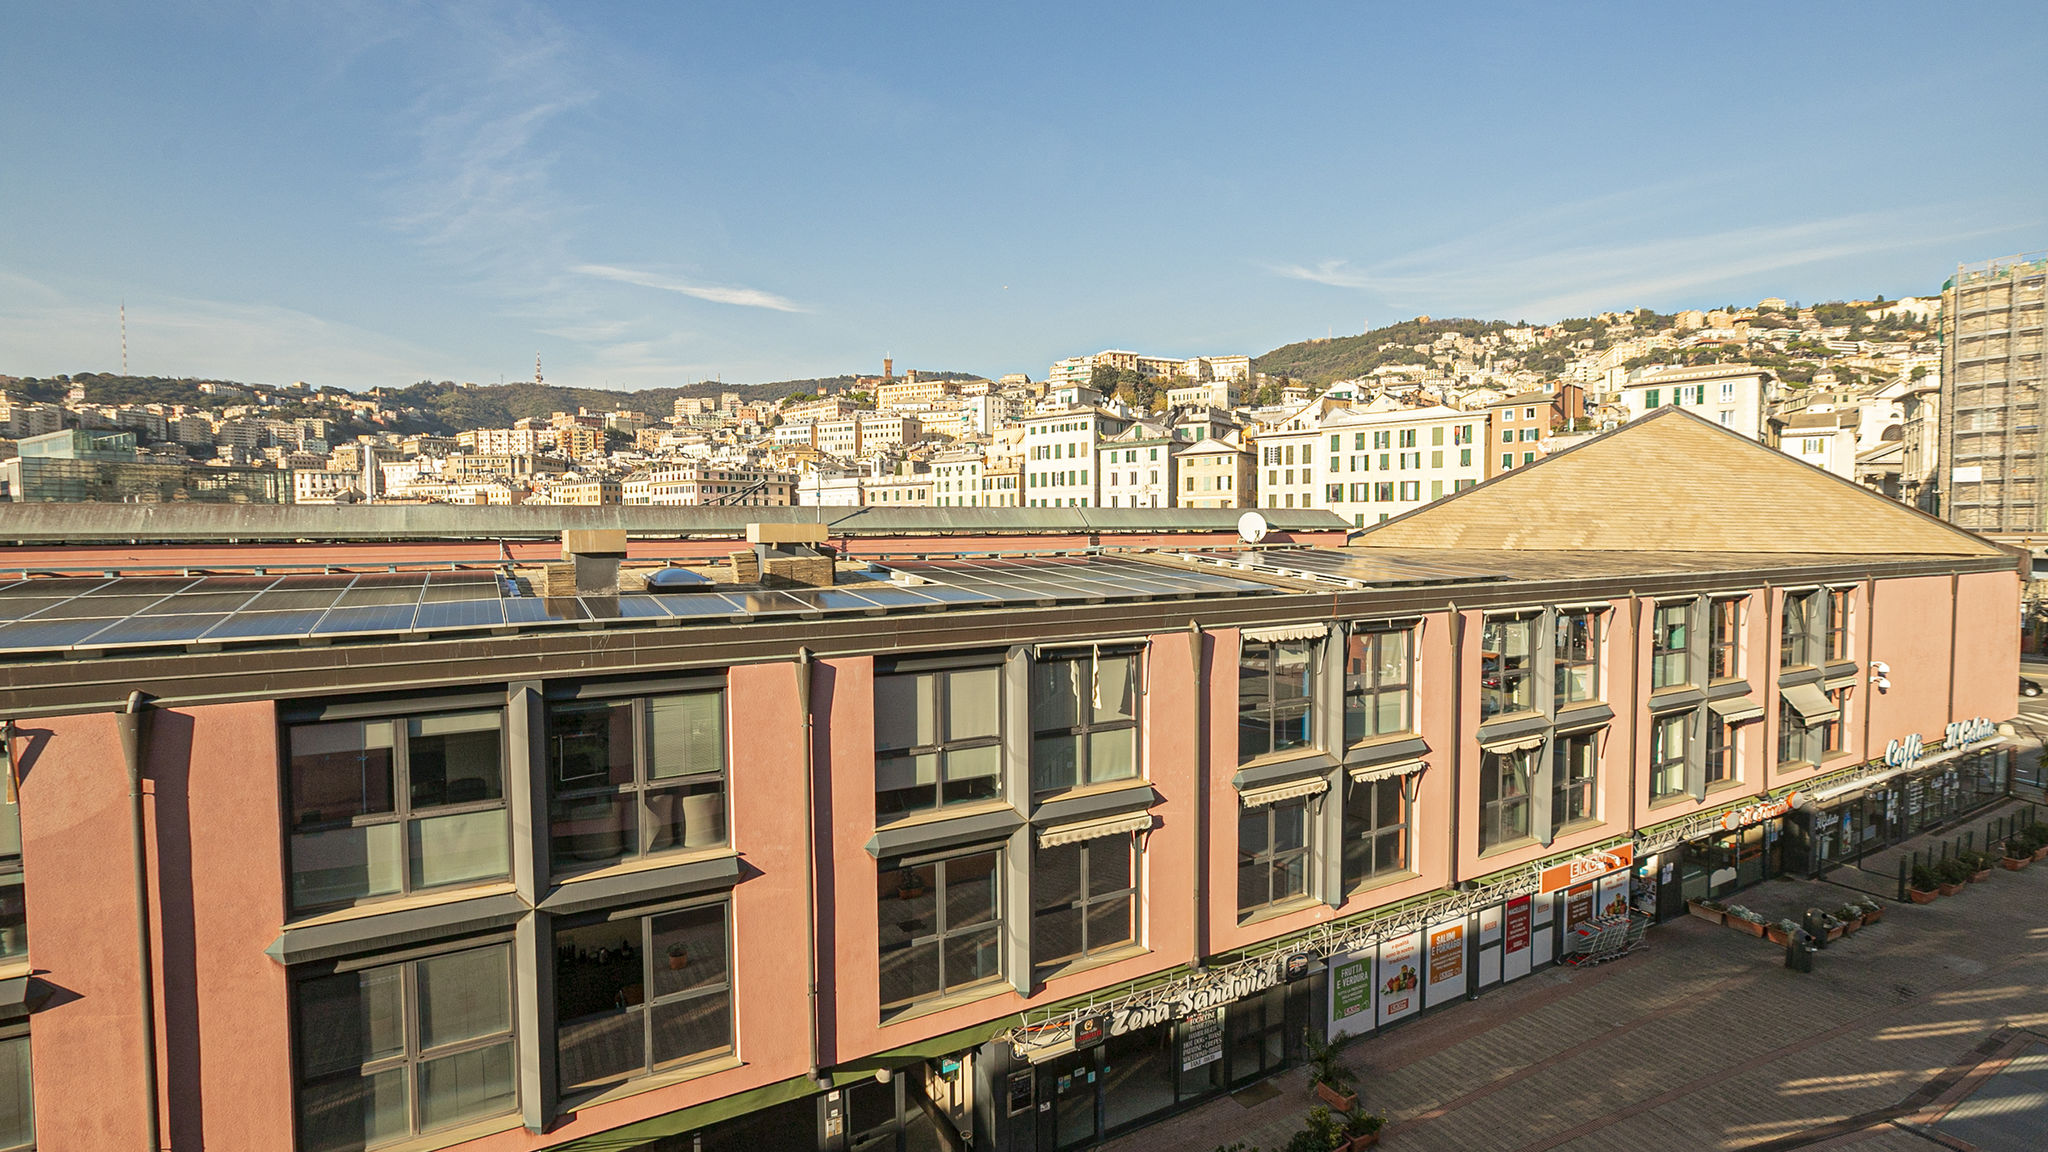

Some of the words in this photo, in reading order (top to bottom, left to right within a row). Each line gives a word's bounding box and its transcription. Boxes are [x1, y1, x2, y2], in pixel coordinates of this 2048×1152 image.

[1336, 981, 1341, 990] E
[1342, 971, 1368, 987] VERDURA
[1341, 964, 1363, 978] FRUTTA
[1110, 1002, 1170, 1036] Zena
[1174, 963, 1278, 1016] Sandwich
